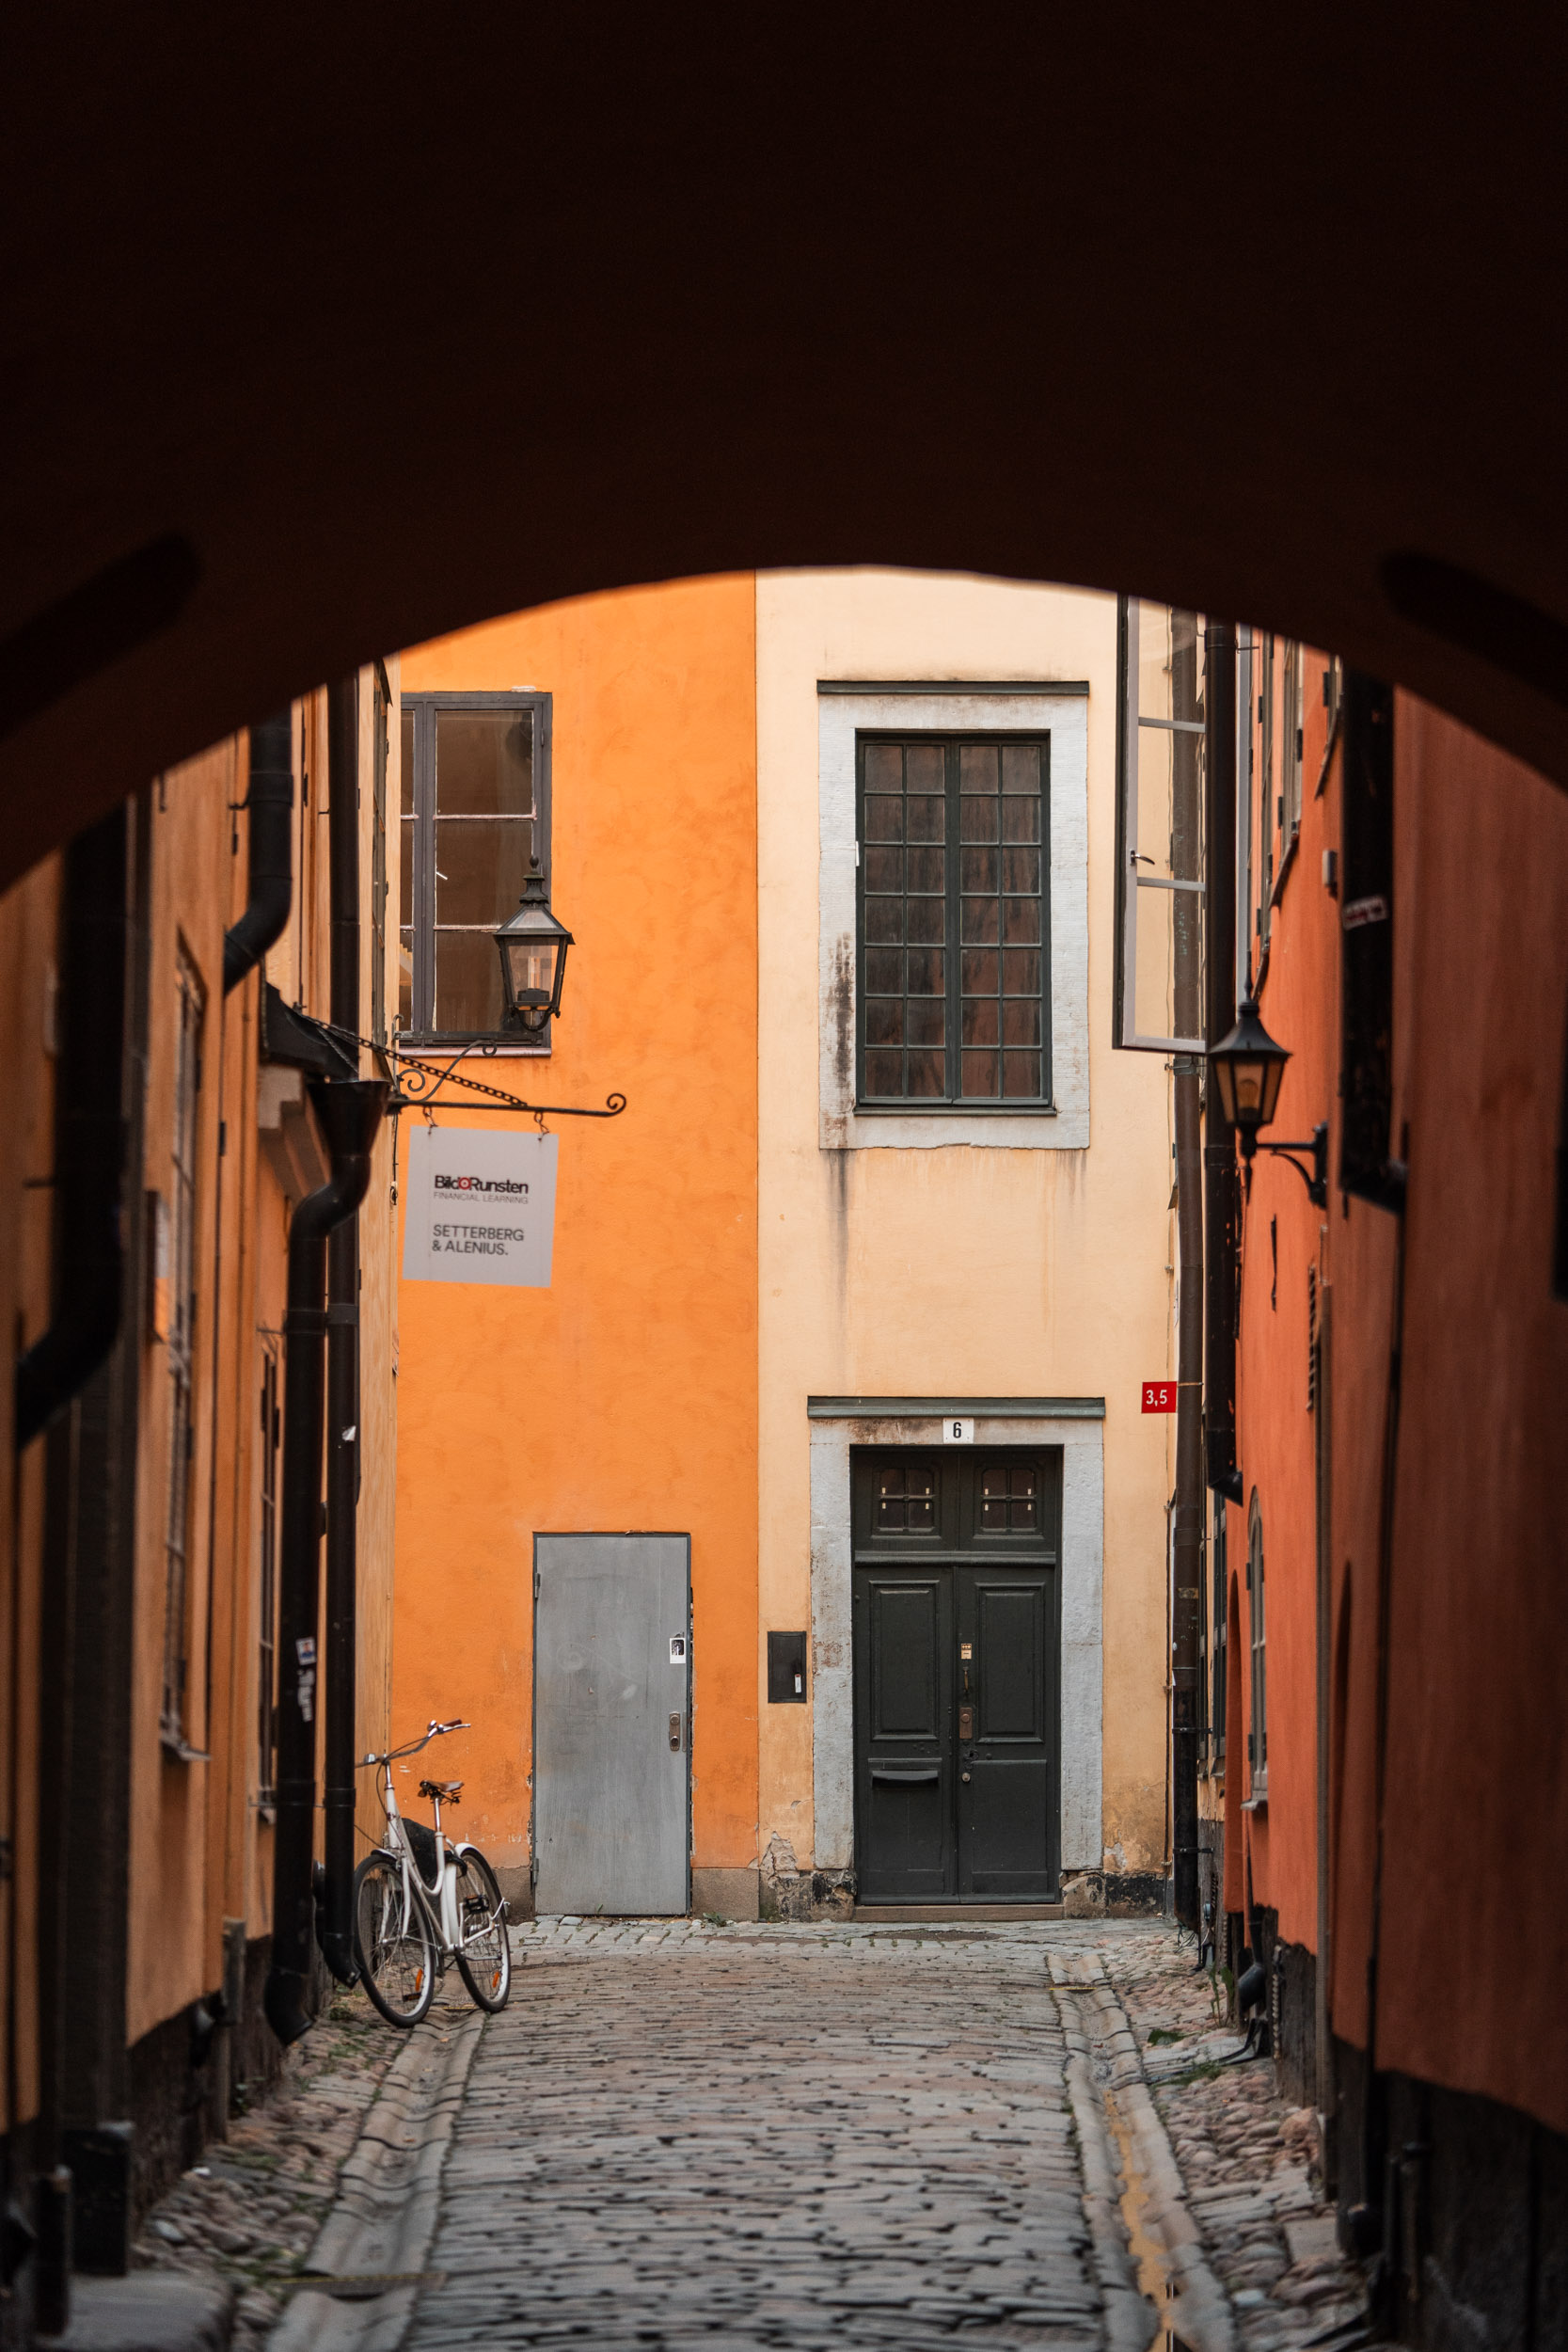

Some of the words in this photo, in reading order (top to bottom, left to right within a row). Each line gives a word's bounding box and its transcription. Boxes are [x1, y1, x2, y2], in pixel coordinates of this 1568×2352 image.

[434, 1192, 480, 1201] FINANCIAL
[483, 1195, 529, 1204] LEARNING
[433, 1224, 524, 1241] SETTERBERG
[432, 1240, 441, 1251] &
[445, 1240, 508, 1255] ALENIUS.
[1146, 1389, 1167, 1406] 3,5
[953, 1422, 962, 1438] 6
